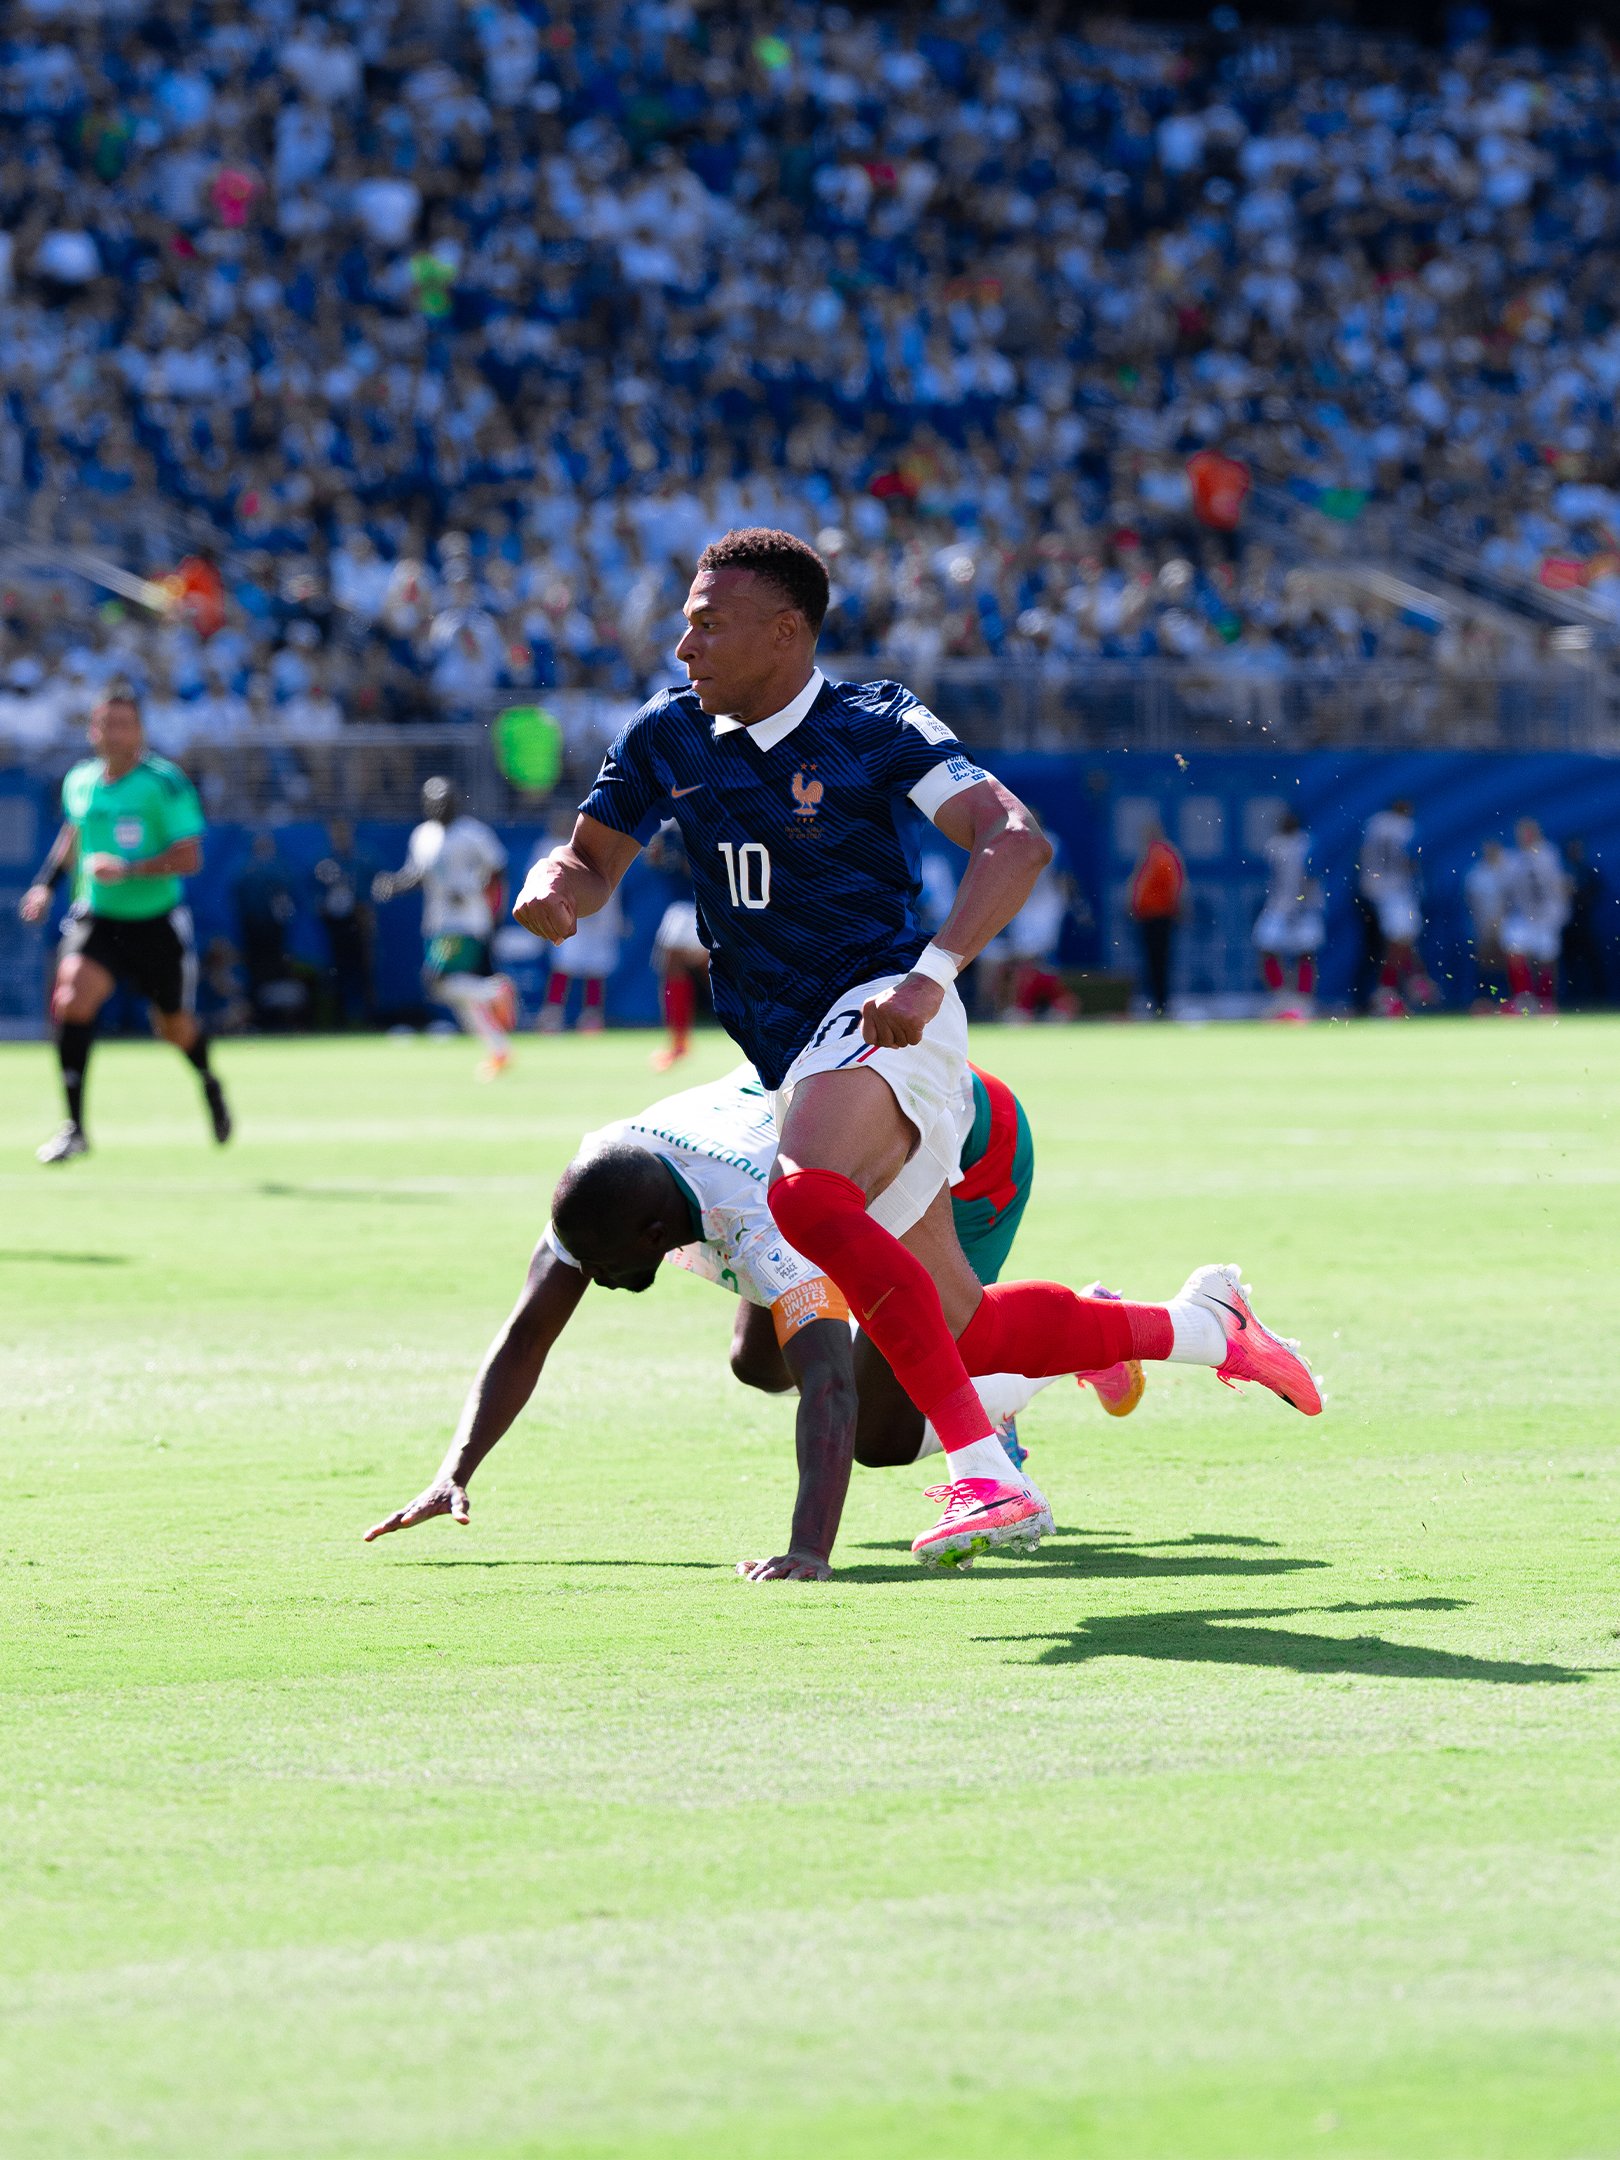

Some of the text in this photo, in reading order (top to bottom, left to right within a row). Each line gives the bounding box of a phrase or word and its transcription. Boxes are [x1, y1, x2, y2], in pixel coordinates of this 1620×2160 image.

[718, 842, 771, 910] 10
[779, 1262, 799, 1279] PEACE
[780, 1281, 825, 1308] FOOTBALL
[784, 1289, 827, 1318] UNITES
[798, 1311, 817, 1326] FIFA
